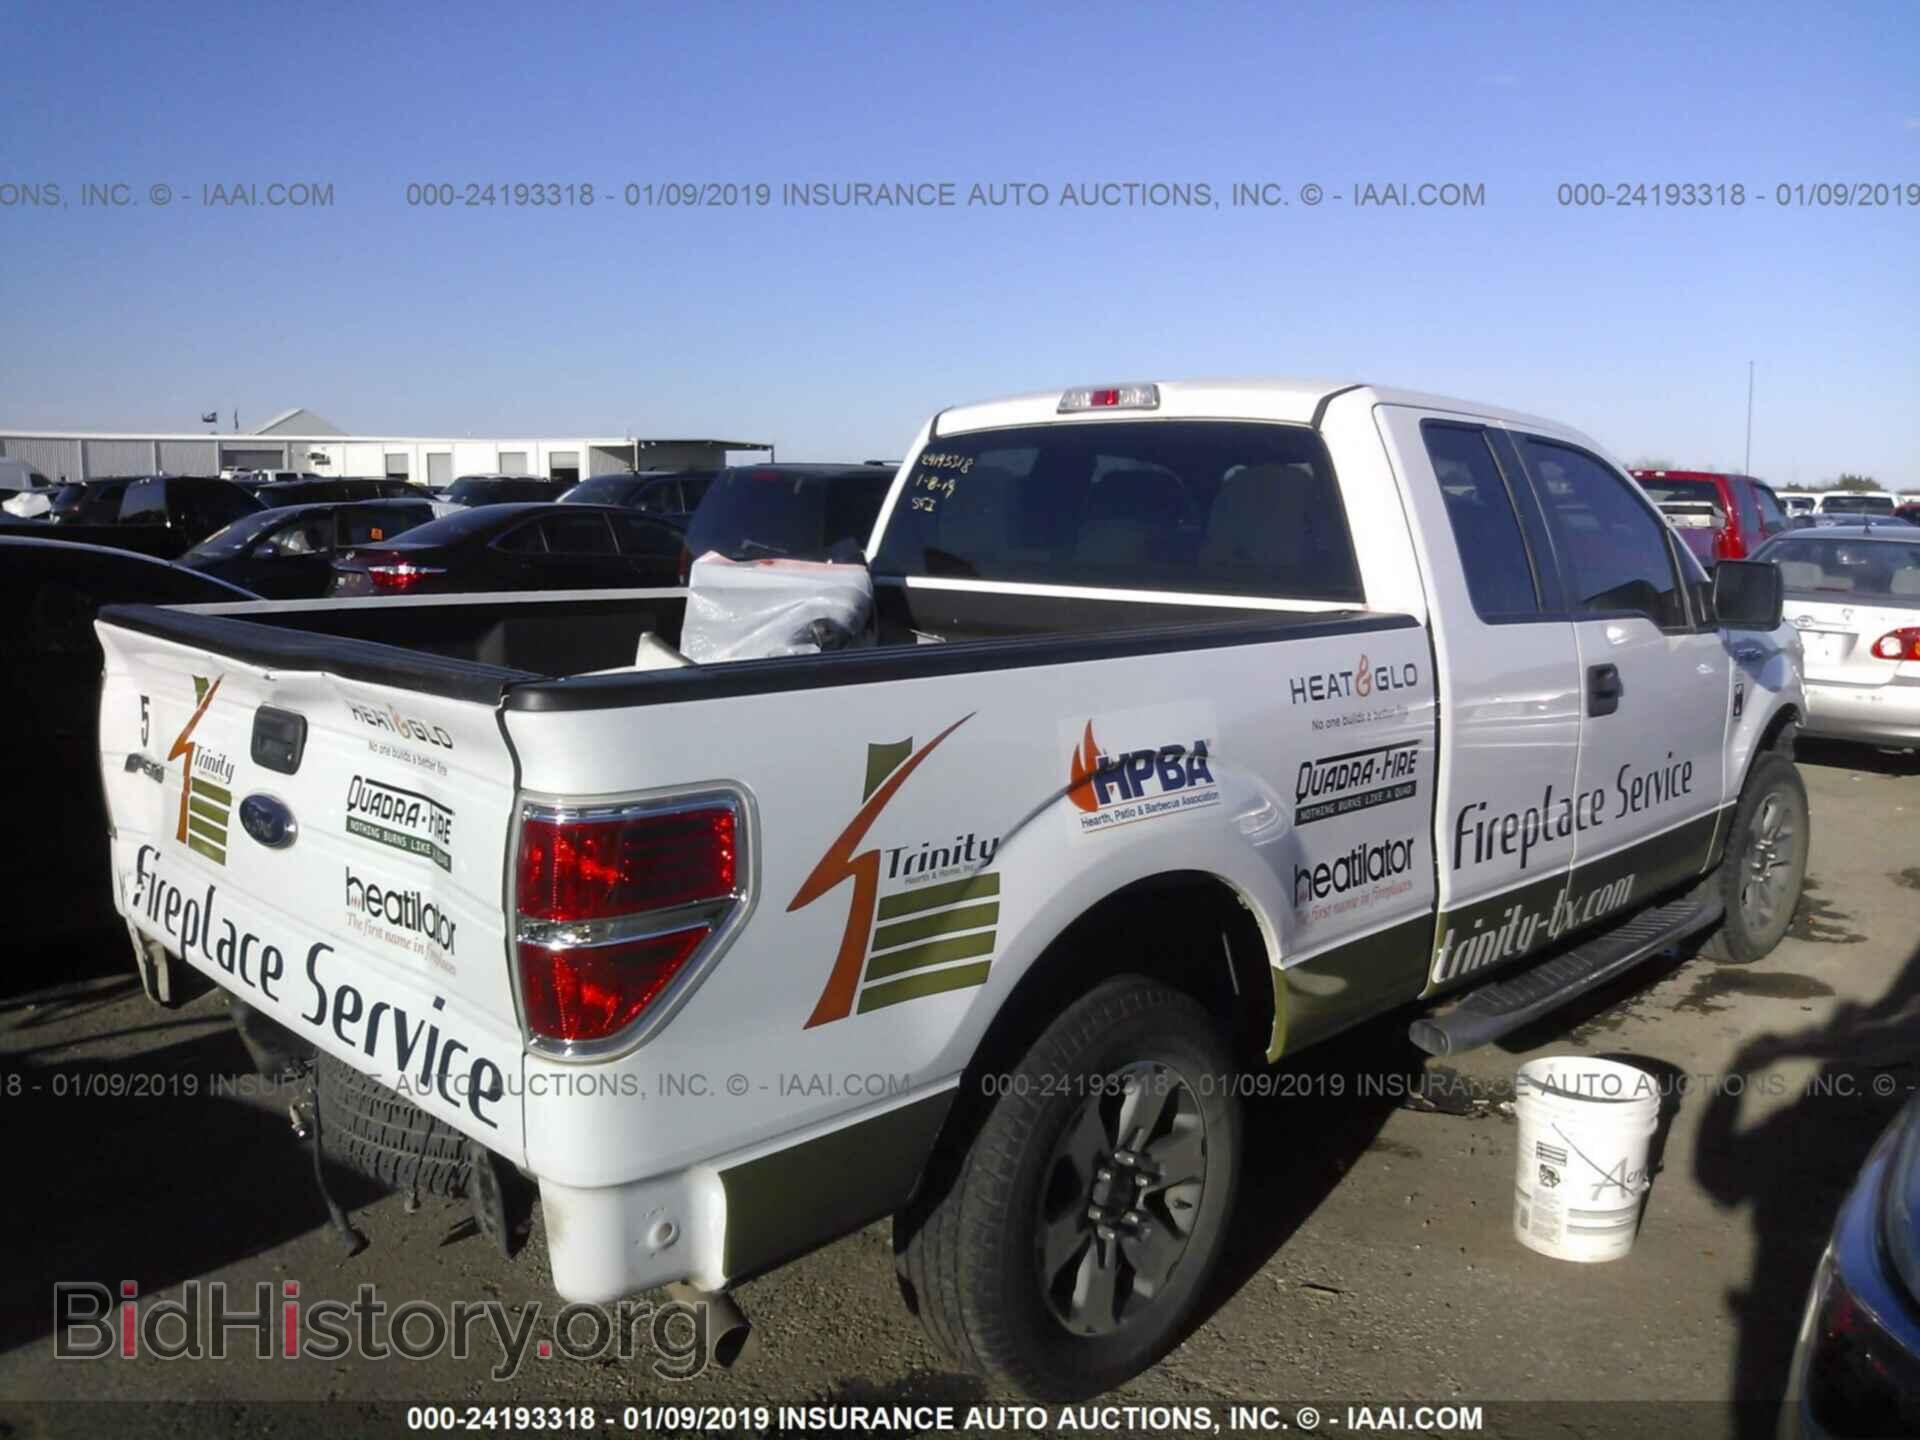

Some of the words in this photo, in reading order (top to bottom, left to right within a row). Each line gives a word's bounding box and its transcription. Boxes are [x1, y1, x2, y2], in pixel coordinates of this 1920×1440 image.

[1289, 670, 1353, 705] HEAT
[1374, 662, 1418, 691] GLO
[140, 694, 150, 748] 5
[407, 718, 454, 750] GLO
[194, 742, 236, 785] Trinity
[1093, 739, 1215, 806] HPBA
[1114, 806, 1136, 820] Patio
[1453, 784, 1606, 871] Fireplace
[1615, 751, 1693, 819] Service
[410, 838, 432, 855] LIKE
[884, 832, 1000, 880] Trinity
[1294, 836, 1414, 909] heatilator
[345, 866, 457, 956] heatilator
[301, 941, 501, 1130] Service
